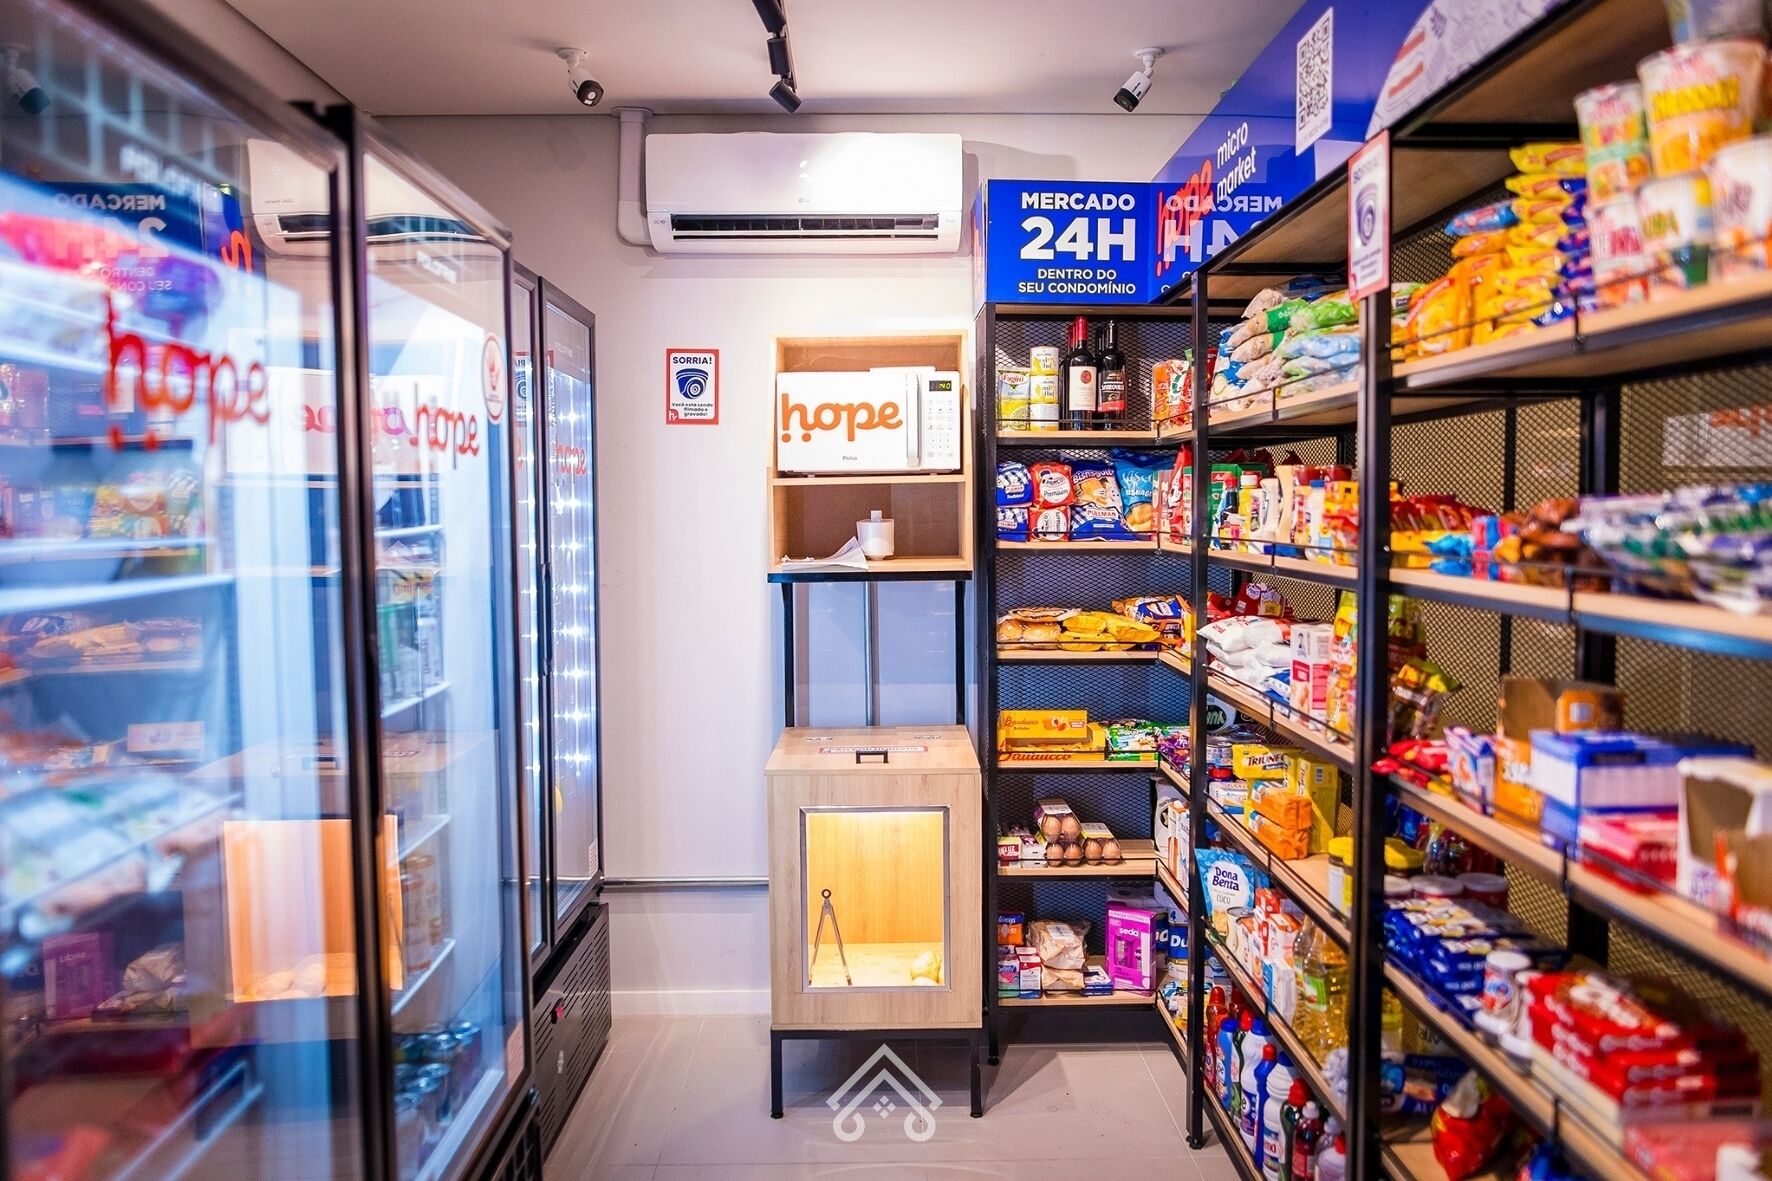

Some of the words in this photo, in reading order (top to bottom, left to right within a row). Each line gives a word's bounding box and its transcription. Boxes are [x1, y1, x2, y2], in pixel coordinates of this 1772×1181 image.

[1216, 122, 1249, 170] micro
[1216, 148, 1257, 204] market
[1021, 192, 1136, 211] MERCADO
[1019, 216, 1136, 262] 24H
[1037, 268, 1093, 280] DENTRO
[1096, 268, 1117, 280] DO
[1018, 282, 1046, 294] SEU
[1048, 280, 1136, 294] CONDOMÍNIO
[672, 356, 713, 365] SORRIA!
[781, 393, 903, 442] hope
[1086, 509, 1117, 517] PULLMAN
[1214, 867, 1238, 881] Dona
[1212, 876, 1240, 891] Benta
[1119, 927, 1139, 937] seda
